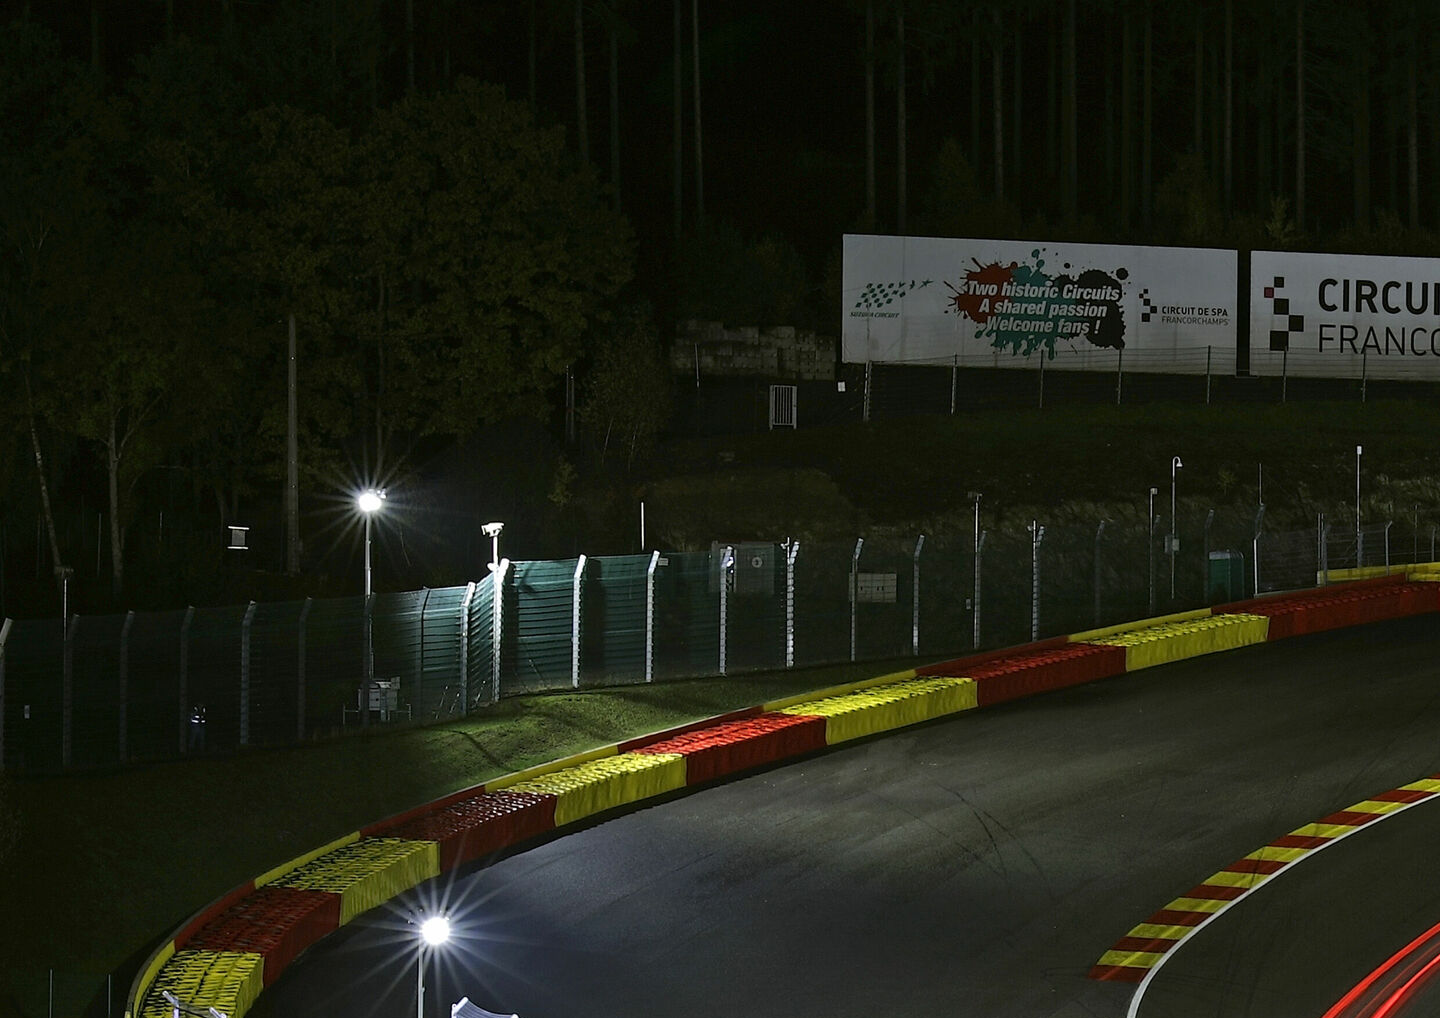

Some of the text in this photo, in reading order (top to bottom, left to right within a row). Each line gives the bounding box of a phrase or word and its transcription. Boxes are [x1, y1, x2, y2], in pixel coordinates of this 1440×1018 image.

[967, 281, 1120, 301] Two historic Circuits
[978, 300, 1108, 320] A shared passion
[1162, 306, 1228, 317] CIRCUIT DE SPA
[985, 317, 1053, 333] Welcome
[1057, 319, 1090, 334] fans
[1162, 316, 1230, 326] FRANCORCHAMPS
